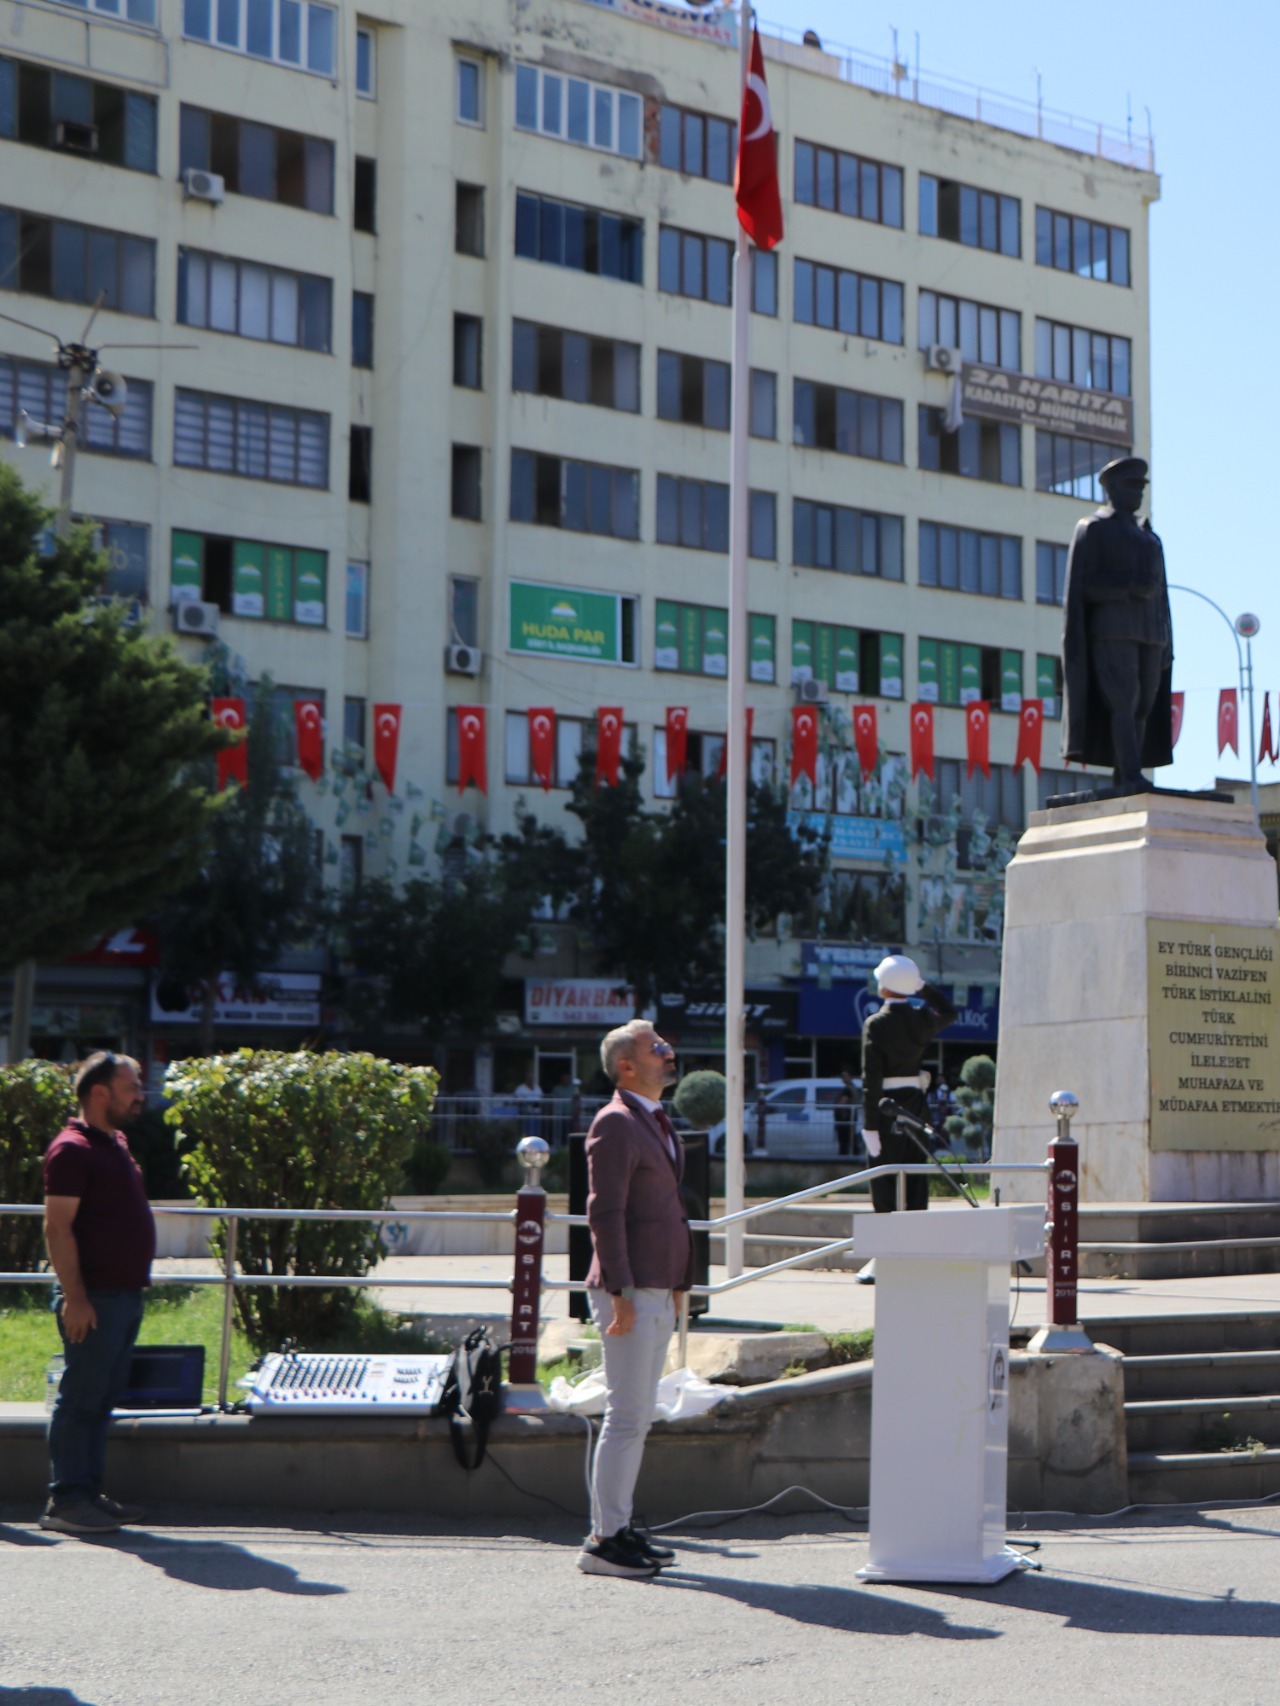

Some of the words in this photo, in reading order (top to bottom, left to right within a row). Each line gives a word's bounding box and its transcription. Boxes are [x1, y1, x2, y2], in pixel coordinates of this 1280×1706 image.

[969, 369, 1010, 391] 2A
[964, 385, 1037, 413] KADASTRO
[573, 628, 605, 645] PAR
[1158, 941, 1175, 954] EY
[1178, 940, 1212, 957] TÜRK
[1214, 945, 1273, 964] GENÇLİĞİ
[1166, 961, 1213, 980] BİRİNCİ
[1215, 966, 1267, 983] VAZİFEN
[1162, 984, 1197, 1000] TÜRK
[1200, 985, 1272, 1005] İSTİKLALİNİ
[1202, 1008, 1236, 1024] TÜRK
[1169, 1030, 1269, 1048] CUMHURİYETİNİ
[1190, 1051, 1251, 1069] İLELEBET
[1178, 1077, 1245, 1091] MUHAFAZA
[1248, 1079, 1264, 1091] VE
[1159, 1096, 1219, 1112] MÜDAFAA
